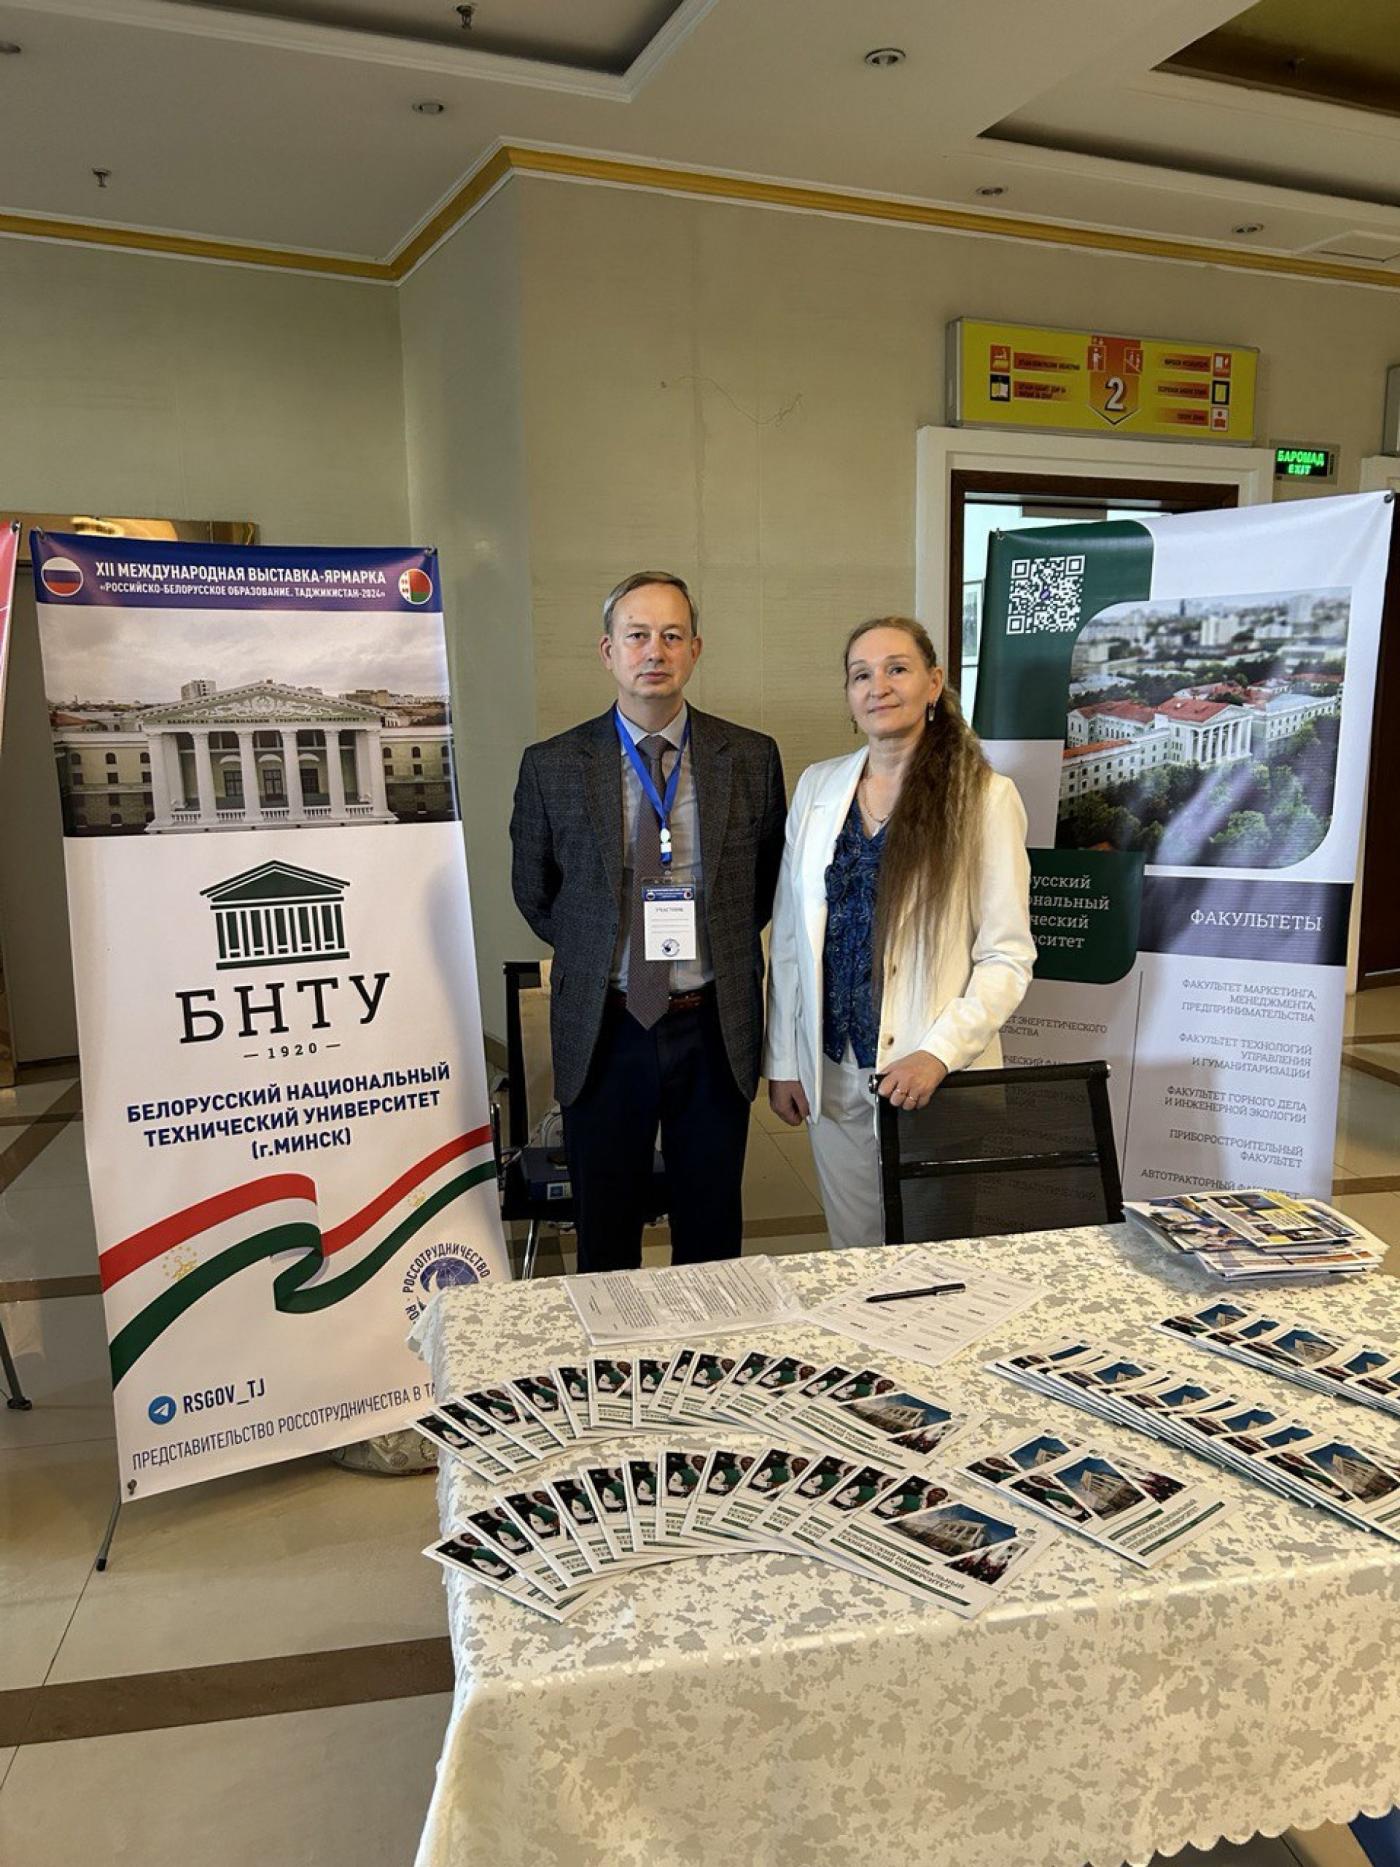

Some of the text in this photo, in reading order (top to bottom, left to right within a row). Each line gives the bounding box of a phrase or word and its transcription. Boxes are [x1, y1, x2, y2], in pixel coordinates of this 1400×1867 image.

[1105, 377, 1125, 411] 2
[1277, 450, 1325, 467] БАРОМАД
[1288, 463, 1311, 475] EXIT
[96, 562, 387, 584] XII МЕЖДУНАРОДНАЯ ВЫСТАВКА-ЯРМАРКА
[100, 581, 227, 596] «РОССИЙСКО-БЕЛОРУССКОЕ
[1032, 874, 1091, 889] усский
[1029, 895, 1110, 911] нальный
[1030, 914, 1089, 929] ческий
[1190, 909, 1323, 932] ФАКУЛЬТЕТЫ
[1182, 978, 1242, 993] ФАКУЛЬТЕТ
[175, 972, 390, 1044] БНТУ
[1181, 1001, 1315, 1023] ПРЕДПРИНИМАТЕЛЬСТВА
[268, 1042, 318, 1060] 1920
[1179, 1032, 1313, 1056] ФАКУЛЬТЕТ ТЕХНОЛОГИЙ
[1192, 1056, 1311, 1079] И ГУМАНИТАРИЗАЦИИ
[1241, 1050, 1311, 1067] УПРАВЛЕНИЯ
[127, 1061, 450, 1123] БЕЛОРУССКИЙ НАЦИОНАЛЬНЫЙ
[1167, 1085, 1307, 1112] ФАКУЛЬТЕТ ГОРНОГО ДЕЛА
[144, 1090, 440, 1147] ТЕХНИЧЕСКИЙ УНИВЕРСИТЕТ
[1165, 1096, 1307, 1124] И ИНЖЕНЕРНОЙ ЭКОЛОГИИ
[252, 1127, 351, 1160] (г.МИНСК)
[1169, 1128, 1304, 1158] ПРИБОРОСТРОИТЕЛЬНЫЙ
[1240, 1151, 1303, 1169] ФАКУЛЬТЕТ
[1141, 1168, 1235, 1191] АВТОТРАКТОРНЫЙ
[402, 1242, 491, 1293] РОССОТРУДНИЧЕСТВО
[183, 1378, 266, 1414] RSGOV_TJ
[132, 1420, 275, 1471] ПРЕДСТАВИТЕЛЬСТВО
[279, 1389, 411, 1434] РОССОТРУДНИЧЕСТВА
[413, 1386, 422, 1401] В
